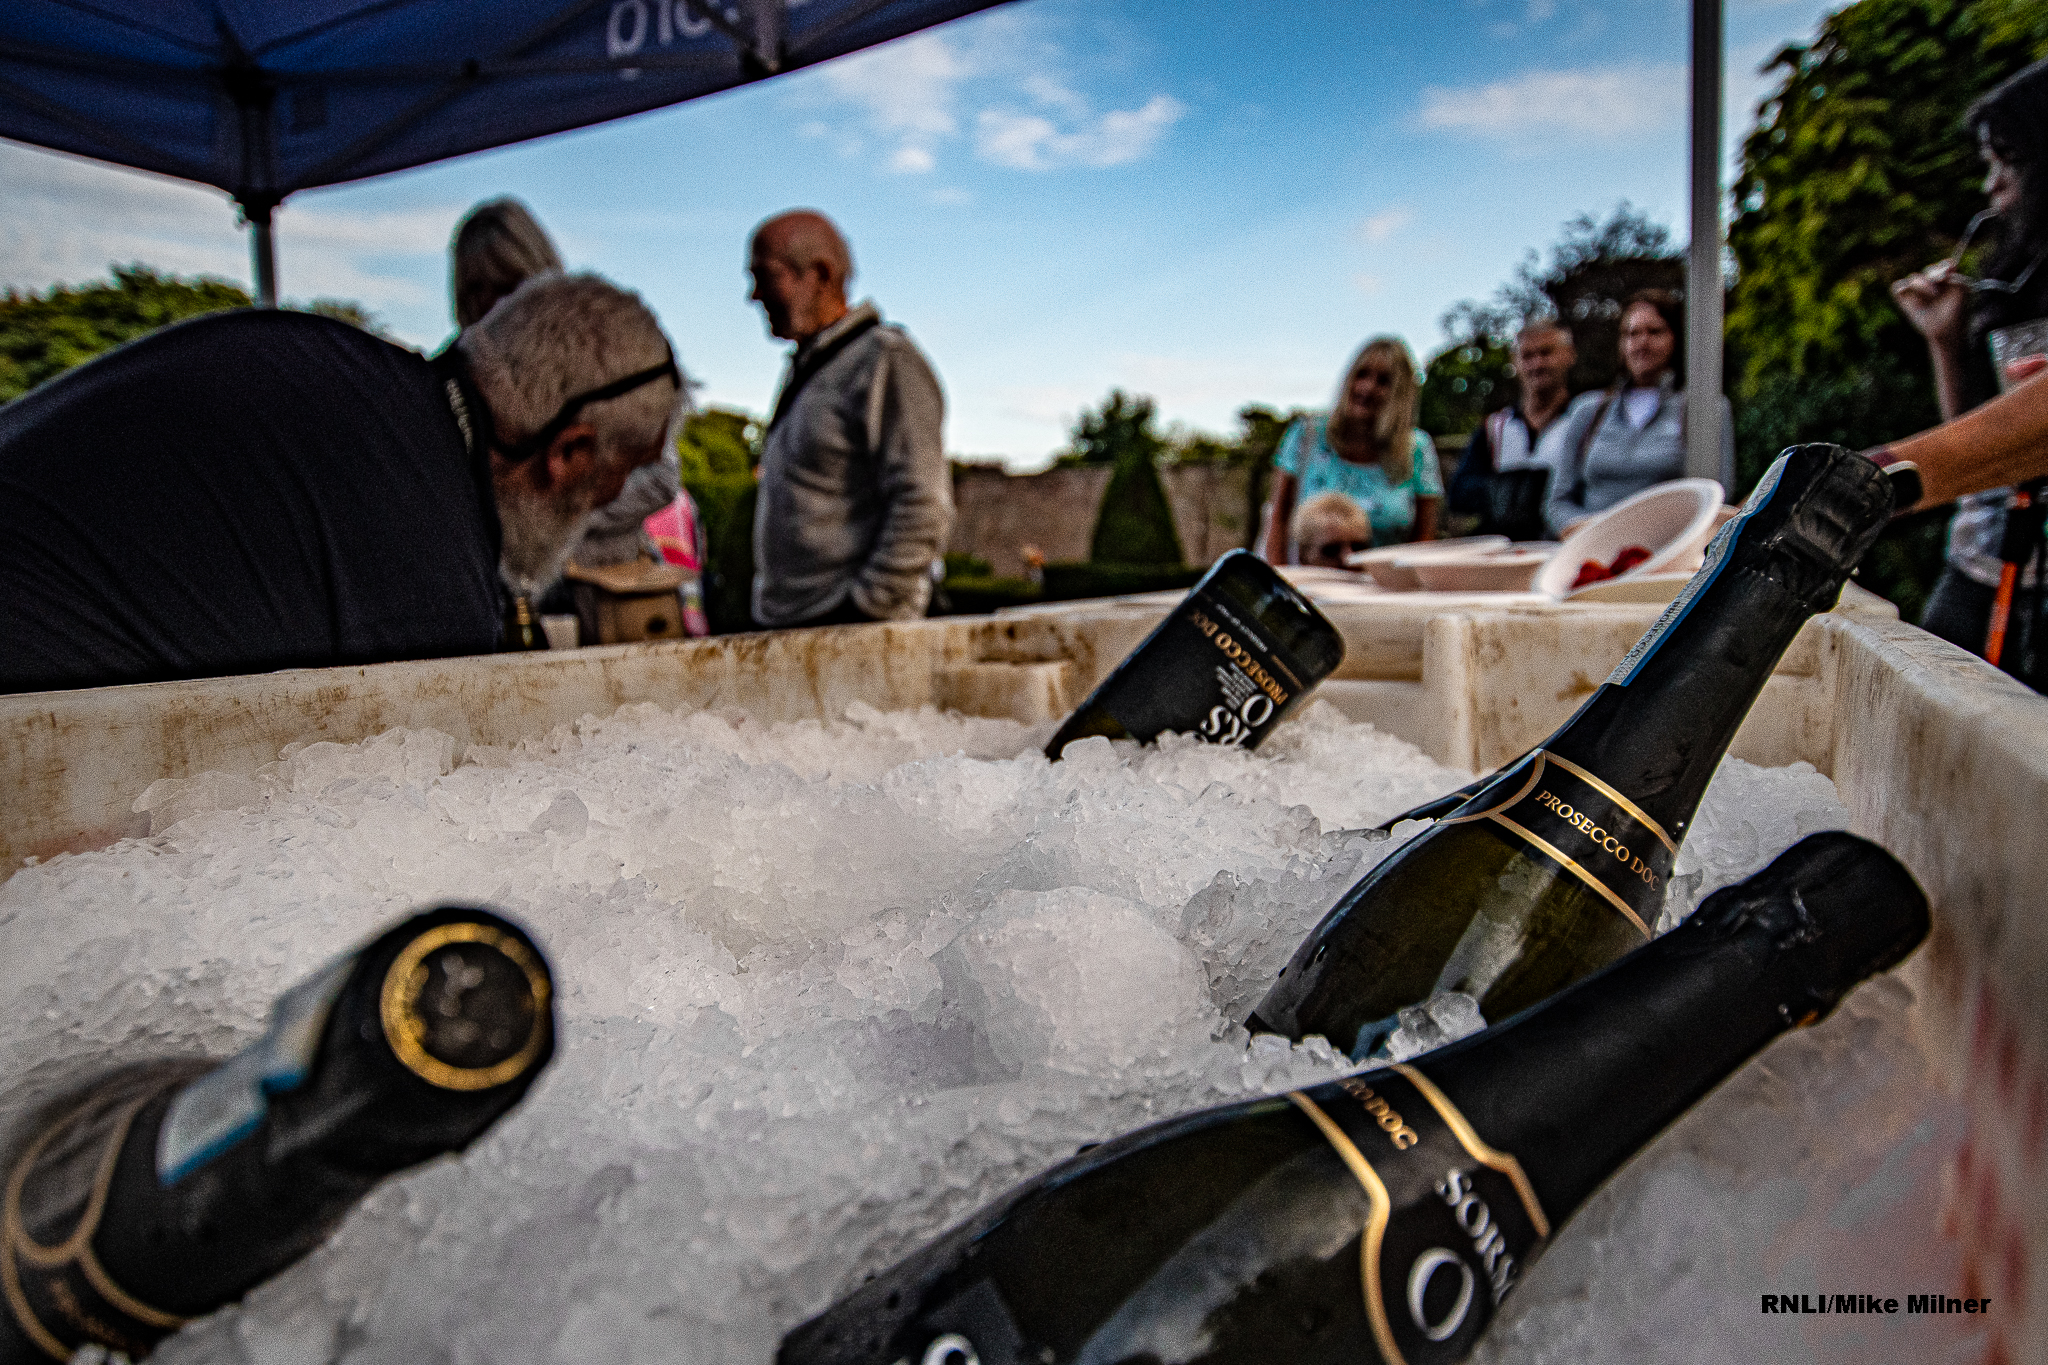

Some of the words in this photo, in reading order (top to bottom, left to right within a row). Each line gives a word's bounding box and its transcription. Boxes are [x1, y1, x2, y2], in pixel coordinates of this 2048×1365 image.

[1215, 632, 1289, 706] PROSECCO
[1535, 790, 1630, 862] PROSECCO
[1630, 856, 1660, 892] DOC
